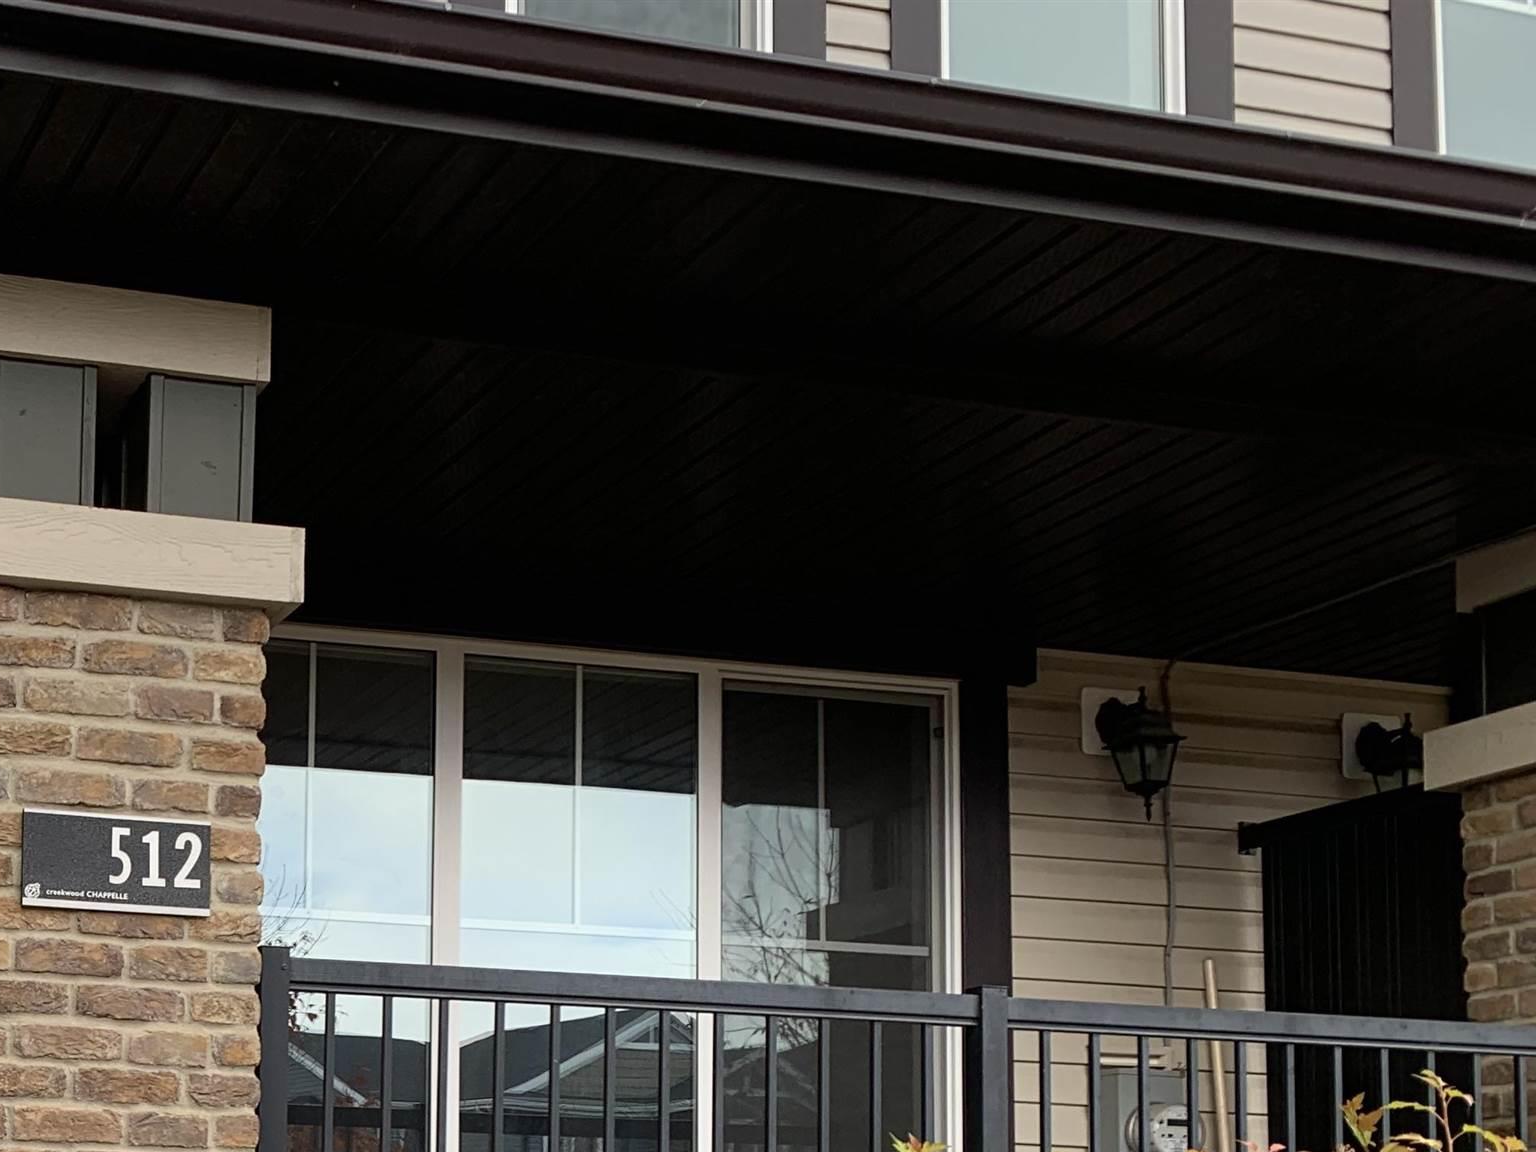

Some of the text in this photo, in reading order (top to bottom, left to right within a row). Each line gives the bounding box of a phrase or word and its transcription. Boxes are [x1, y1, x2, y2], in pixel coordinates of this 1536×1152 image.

[109, 826, 203, 889] 512
[46, 888, 129, 900] creekwood CHAPPELLE
